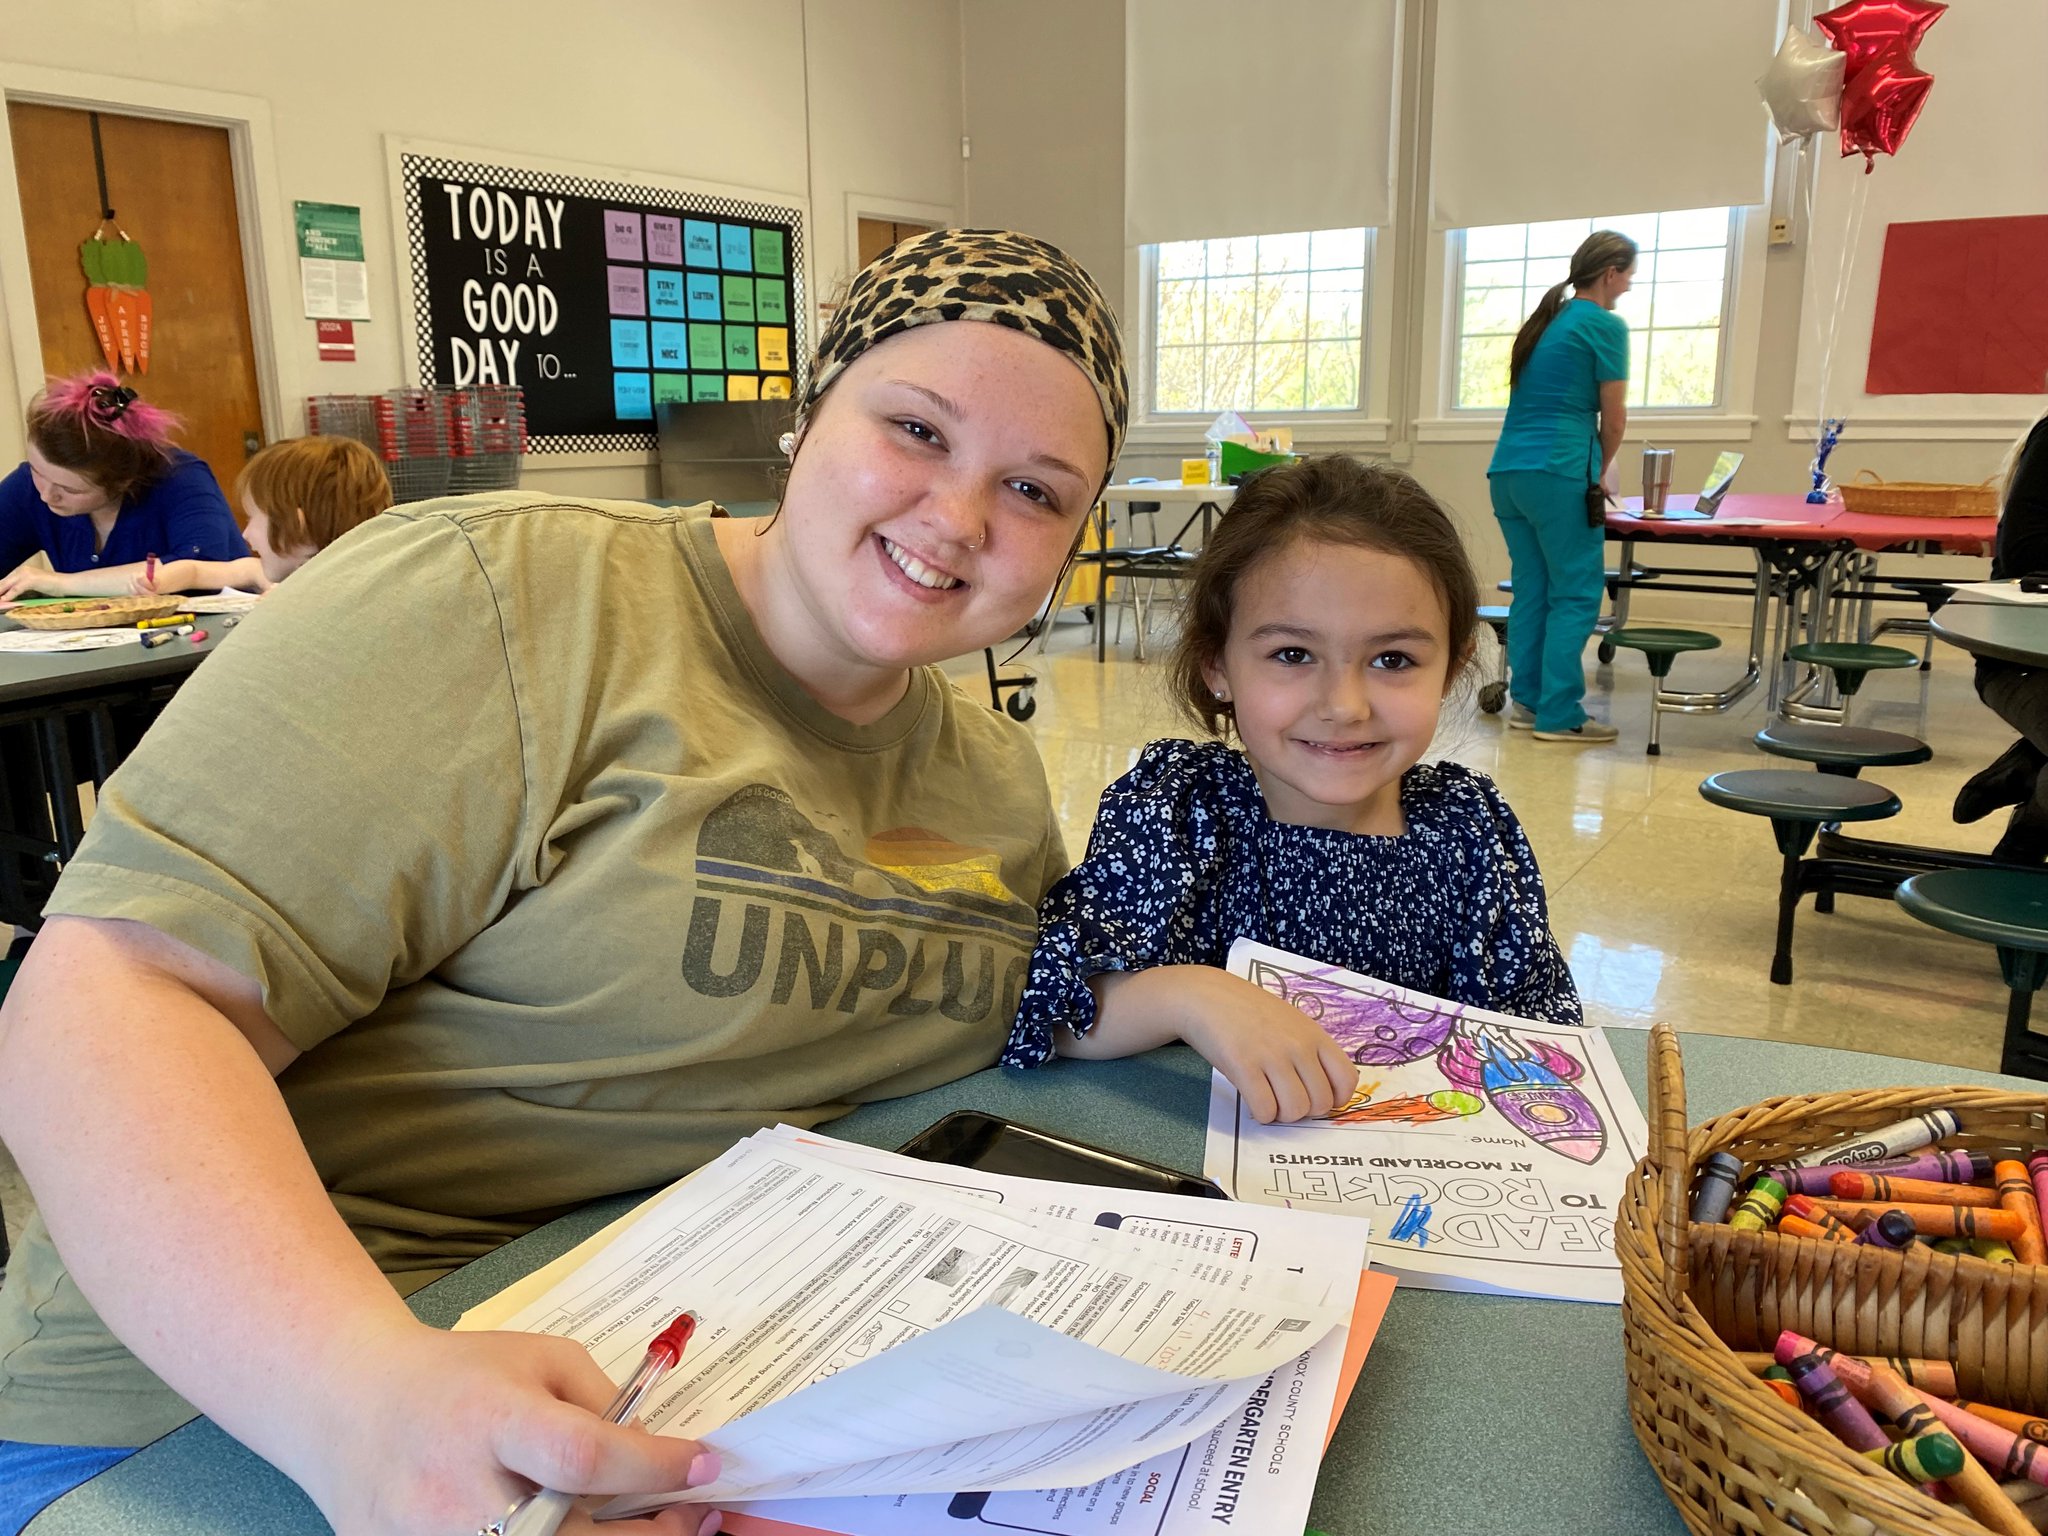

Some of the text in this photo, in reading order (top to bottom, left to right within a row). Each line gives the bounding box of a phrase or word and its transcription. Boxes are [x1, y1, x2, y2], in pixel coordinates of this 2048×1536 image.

[443, 183, 565, 250] TODAY
[484, 247, 544, 278] IS A
[463, 278, 559, 336] GOOD
[450, 336, 520, 389] DAY
[660, 348, 679, 360] NICE
[1464, 1134, 1526, 1149] Name:
[1269, 1153, 1532, 1173] AT MOORELAND HEIGHTS!
[785, 1174, 820, 1199] Email Address
[1263, 1168, 1606, 1213] TO ROCKET
[797, 1181, 841, 1215] Telephone Number
[835, 1195, 884, 1235] Home Street Address
[888, 1245, 905, 1258] family
[1228, 1237, 1243, 1258] LETTE
[832, 1256, 855, 1274] question
[861, 1257, 877, 1268] Years
[862, 1268, 881, 1282] moved
[810, 1280, 828, 1293] please
[847, 1283, 864, 1295] within
[870, 1284, 887, 1296] family
[1109, 1284, 1123, 1295] Have
[642, 1296, 659, 1306] Best
[786, 1294, 812, 1313] complete
[1066, 1294, 1082, 1307] Check
[1091, 1289, 1107, 1304] United
[1118, 1282, 1148, 1310] School Name
[1154, 1290, 1173, 1307] Student
[852, 1298, 872, 1312] moved
[1076, 1305, 1093, 1321] States,
[1180, 1298, 1199, 1315] Today's
[649, 1306, 681, 1327] Language
[661, 1235, 870, 1408] Migrant Education Program follow your family verify qualify
[1133, 1319, 1147, 1331] Name
[606, 1321, 625, 1332] Week
[826, 1320, 848, 1336] another
[745, 1323, 778, 1348] information
[773, 1328, 796, 1344] Months
[785, 1333, 809, 1350] Indicate
[771, 1352, 786, 1362] how
[758, 1363, 774, 1374] long
[779, 1363, 801, 1379] school
[725, 1385, 749, 1402] below.
[757, 1380, 782, 1400] district,
[678, 1409, 703, 1426] Weeks
[1267, 1350, 1311, 1474] KNOX COUNTY SCHOOLS
[1201, 1430, 1224, 1465] succeed
[1198, 1467, 1212, 1476] at
[1119, 1486, 1133, 1499] new
[1138, 1473, 1161, 1505] SOCIAL
[1186, 1478, 1209, 1512] school.
[1210, 1471, 1245, 1522] ENTRY
[1051, 1487, 1073, 1520] directions
[1087, 1498, 1098, 1507] on
[1109, 1502, 1127, 1525] groups
